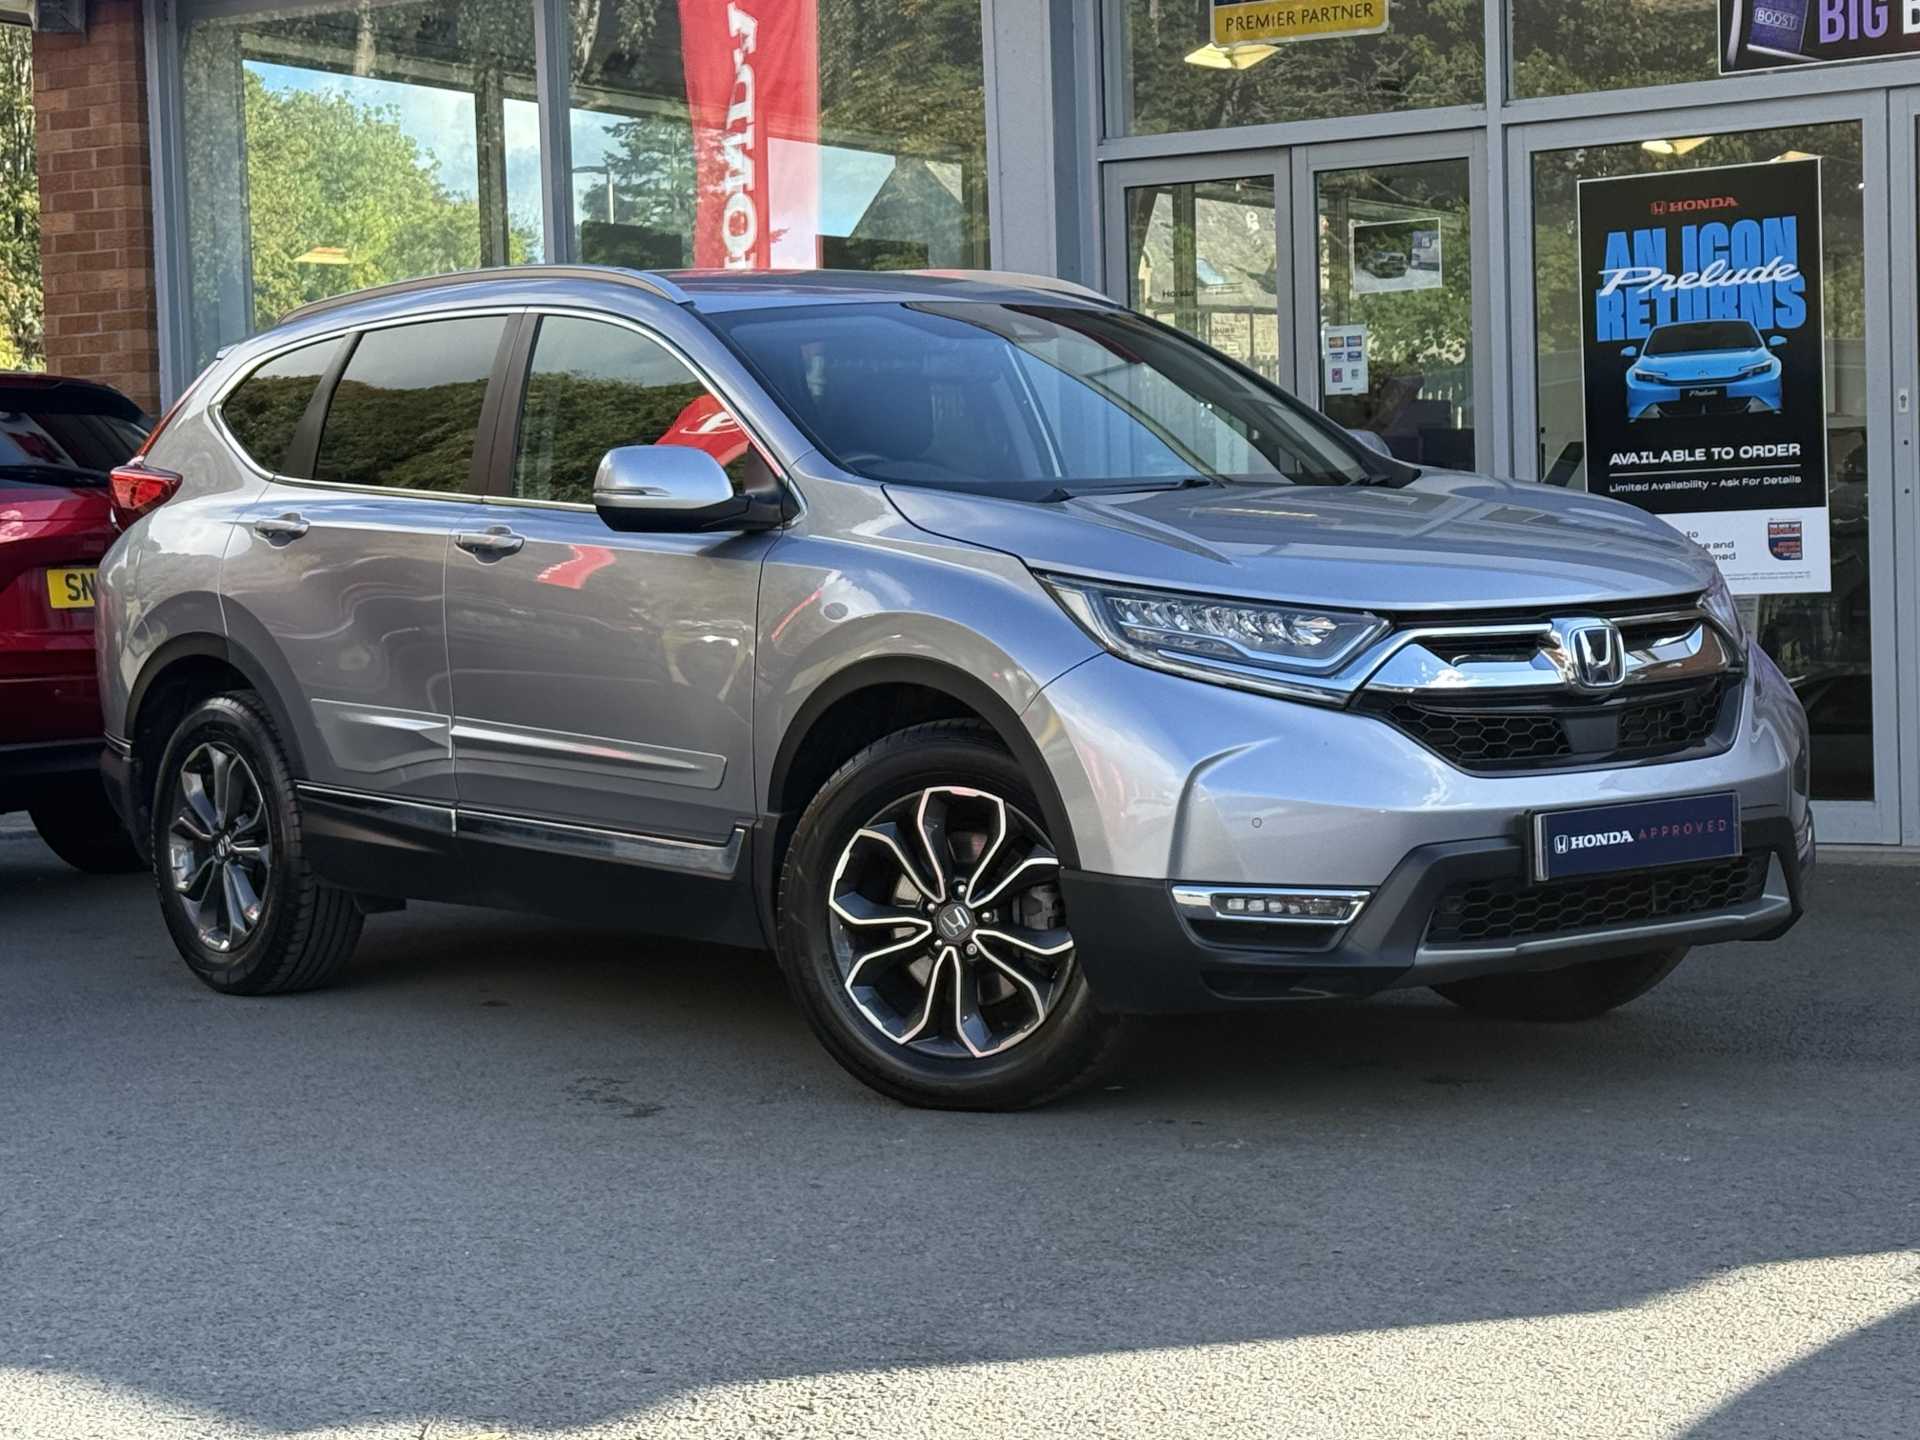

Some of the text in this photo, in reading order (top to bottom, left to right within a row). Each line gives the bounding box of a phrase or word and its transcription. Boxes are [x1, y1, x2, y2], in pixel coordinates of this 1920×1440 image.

[1226, 3, 1374, 32] PREMIER PARTNER
[1756, 9, 1795, 27] BOOST
[1818, 0, 1889, 43] BIG
[1669, 196, 1739, 213] HONDA
[1604, 215, 1799, 284] AN ICON
[1598, 255, 1801, 296] Prelude
[1596, 273, 1806, 342] RETURNS
[1609, 443, 1801, 466] AVAILABLE TO ORDER
[1609, 480, 1649, 493] Limited
[1651, 478, 1709, 491] Availability
[1719, 477, 1740, 487] Ask
[1742, 476, 1761, 486] For
[1763, 474, 1801, 485] Details
[1713, 540, 1735, 549] and
[64, 573, 95, 601] SN
[1570, 819, 1727, 850] HONDA APPROVED
